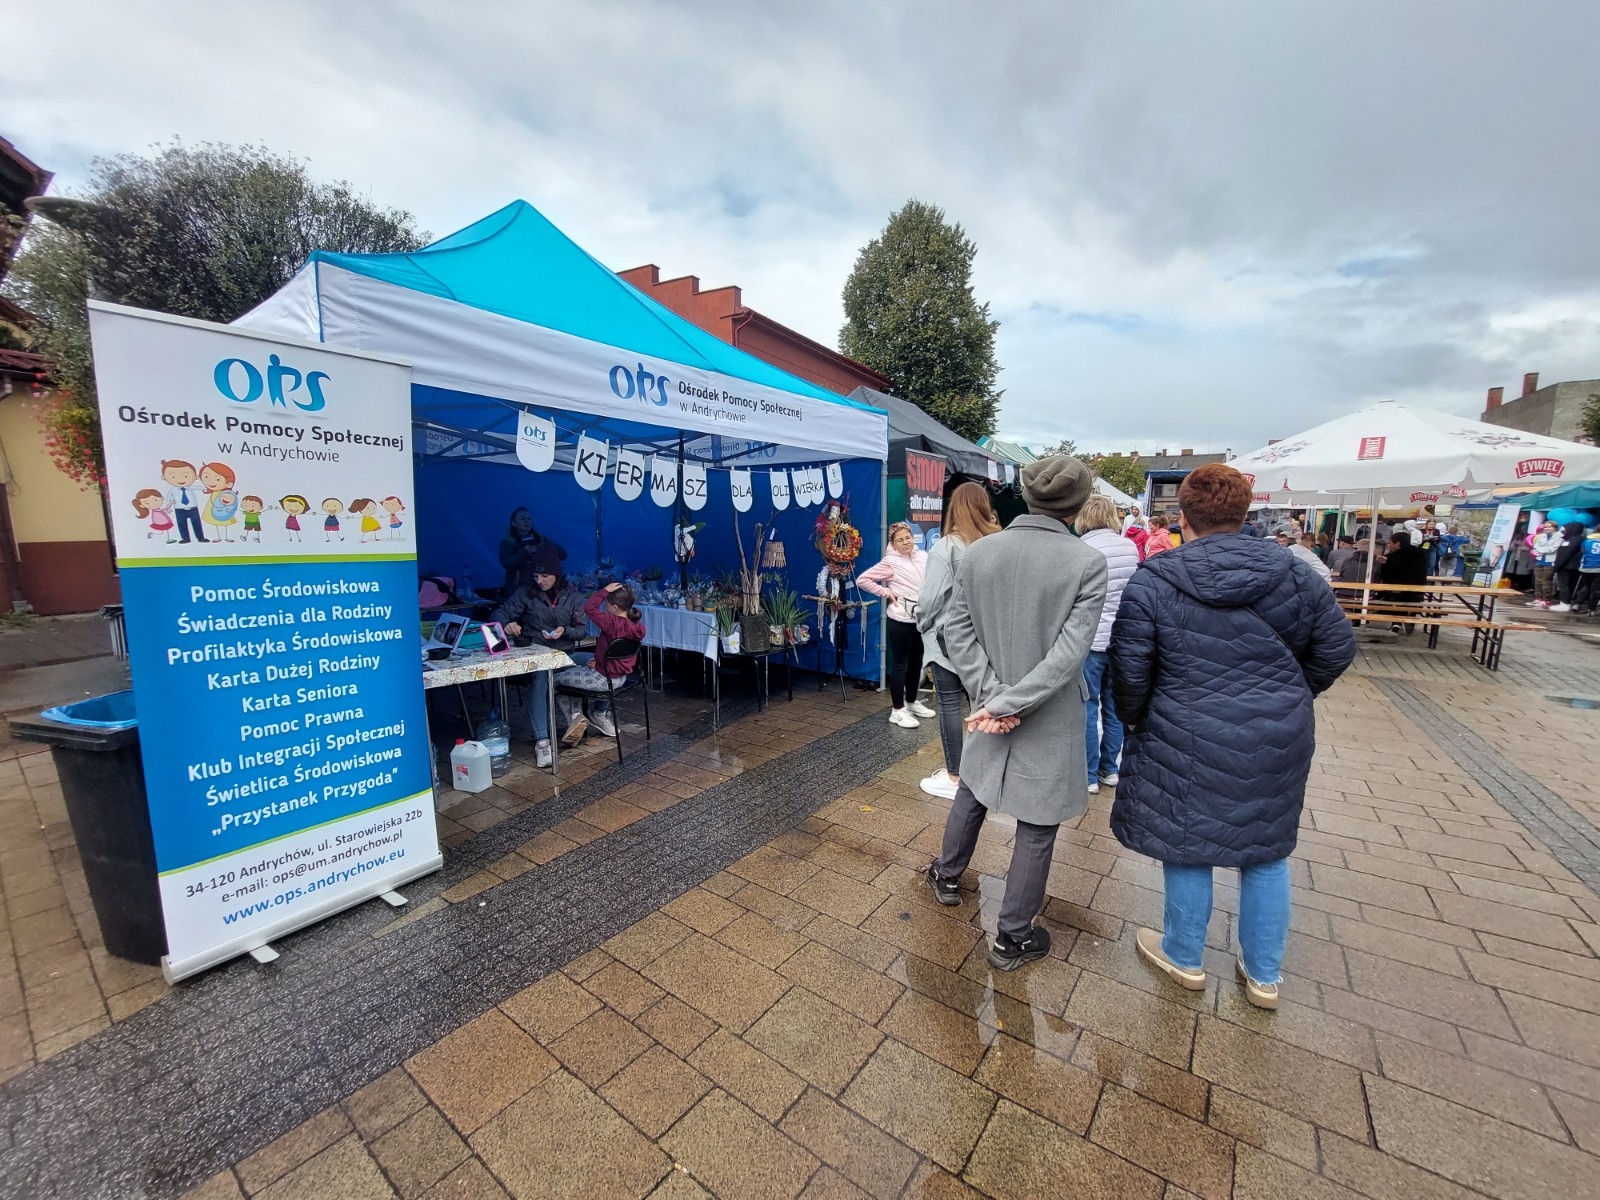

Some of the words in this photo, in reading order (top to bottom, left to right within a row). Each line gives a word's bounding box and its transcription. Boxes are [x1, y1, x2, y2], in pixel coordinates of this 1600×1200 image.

[214, 354, 331, 411] OPS
[609, 362, 670, 406] OPS
[679, 381, 719, 401] Ośrodek
[723, 391, 757, 411] Pomocy
[761, 399, 802, 421] Społecznej
[118, 405, 216, 431] Ośrodek
[226, 416, 305, 442] Pomocy
[311, 425, 404, 451] Społecznej
[680, 402, 688, 412] w
[692, 402, 746, 423] Andrychowie
[218, 441, 232, 454] w
[240, 441, 340, 463] Andrychowie
[1521, 460, 1560, 473] ŻYWIEC
[732, 485, 752, 497] DLA
[190, 584, 257, 604] Pomoc
[262, 578, 380, 599] Środowiskowa
[177, 609, 295, 635] Świadczenia
[300, 605, 327, 624] dla
[331, 603, 392, 624] Rodziny
[167, 636, 286, 666] Profilaktyka
[292, 627, 403, 651] Środowiskowa
[207, 669, 260, 691] Karta
[266, 661, 313, 683] Dużej
[318, 653, 381, 675] Rodziny
[242, 693, 292, 714] Karta
[296, 681, 358, 702] Seniora
[240, 720, 300, 742] Pomoc
[305, 706, 365, 728] Prawna
[188, 758, 233, 782] Klub
[238, 739, 321, 771] Integracji
[326, 720, 405, 752] Społecznej
[205, 773, 289, 806] Świetlica
[293, 746, 402, 783] Środowiskowa
[186, 871, 235, 897] 34-120
[240, 845, 314, 879] Andrychów,
[318, 839, 332, 852] ul.
[335, 817, 402, 846] Starowiejska
[405, 809, 422, 824] 22b
[221, 878, 268, 902] e-mail:
[273, 830, 402, 885] ops@um.andrychow.pl
[222, 848, 405, 924] www.ops.andrychow.eu
